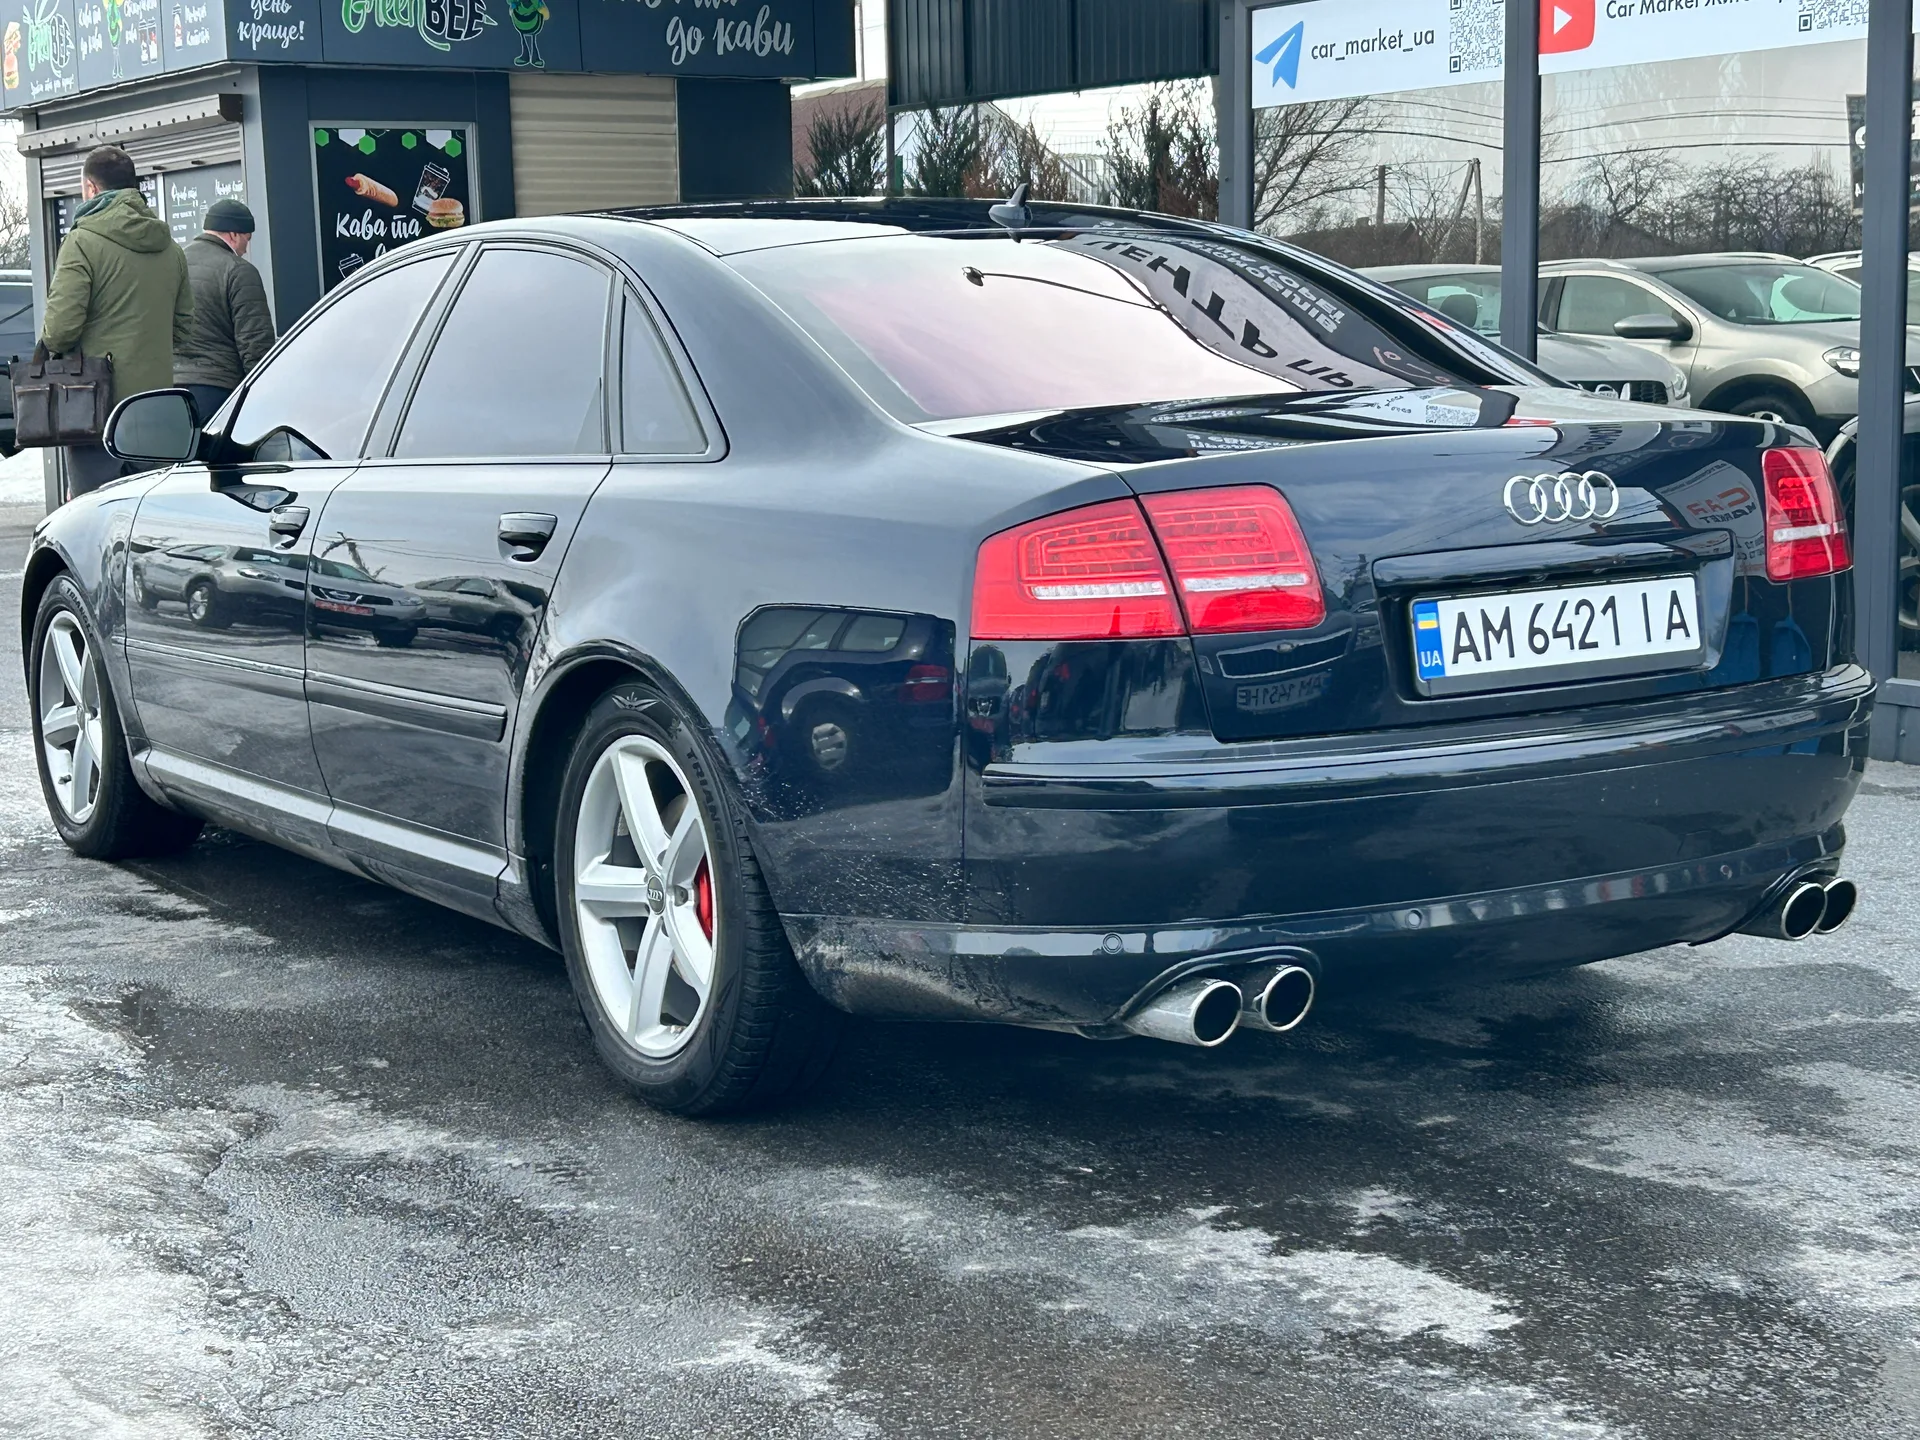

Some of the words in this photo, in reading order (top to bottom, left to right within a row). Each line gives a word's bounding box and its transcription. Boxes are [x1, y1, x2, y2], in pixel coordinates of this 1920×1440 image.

[1606, 1, 1634, 19] Car
[237, 20, 305, 50] краще!
[666, 15, 705, 65] до
[712, 5, 795, 57] кави
[1311, 28, 1435, 61] car_market_ua
[336, 208, 388, 241] Кава
[390, 214, 423, 239] та
[1451, 606, 1515, 664] AM
[1528, 596, 1620, 655] 6421
[1421, 650, 1442, 668] UA
